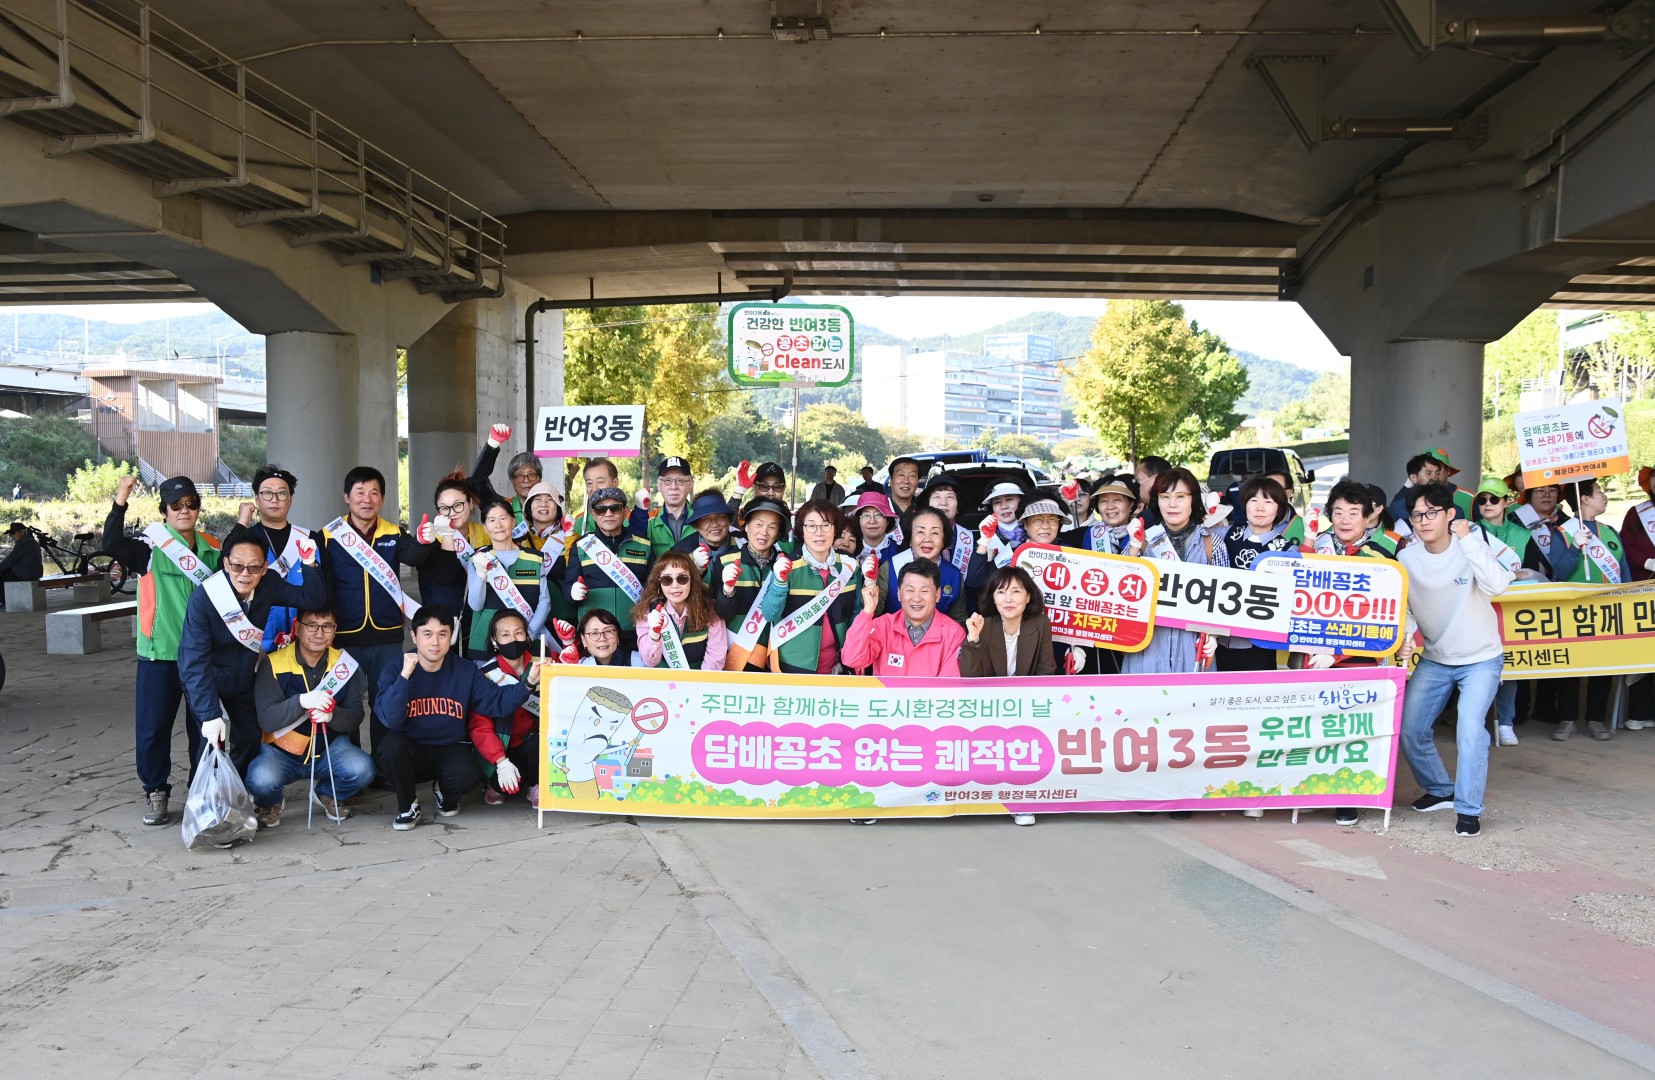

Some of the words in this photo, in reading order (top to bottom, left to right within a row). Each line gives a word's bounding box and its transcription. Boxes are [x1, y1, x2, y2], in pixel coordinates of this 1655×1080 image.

[746, 317, 784, 330] 건강한
[789, 317, 841, 333] 반여3동
[777, 335, 843, 352] 꽁초없는
[774, 354, 845, 370] Clean도시
[544, 415, 634, 442] 반여3동
[1522, 421, 1569, 437] 담배꽁초는
[1525, 438, 1534, 449] 꼭
[1537, 430, 1584, 447] 쓰레기통에
[1554, 465, 1580, 476] 해운대구
[1583, 461, 1608, 472] 반여4동
[357, 542, 388, 571] 담배꽁초
[1028, 550, 1056, 561] 반여3동
[612, 560, 640, 590] 담배꽁초
[1293, 569, 1372, 592] 담배꽁초
[1043, 592, 1056, 606] 집
[1059, 595, 1072, 608] 앞
[1075, 597, 1139, 619] 담배꽁초는
[1156, 573, 1280, 621] 반여3동
[793, 595, 830, 627] 담배꽁초
[1514, 606, 1563, 640] 우리
[1572, 602, 1624, 637] 함께
[745, 610, 764, 635] NO
[777, 619, 797, 639] NO
[1051, 625, 1075, 635] 반여3동
[1075, 628, 1113, 642] 행정복지센터
[1072, 612, 1118, 633] 치우자
[1325, 622, 1394, 640] 쓰레기통에
[661, 630, 683, 669] 담배꽁초
[1299, 636, 1324, 644] 반여3동
[701, 693, 767, 715] 주민과
[773, 696, 860, 718] 함께하는
[867, 698, 1023, 719] 도시환경정비의
[1031, 698, 1053, 718] 날
[1209, 696, 1226, 707] 살기
[1227, 696, 1242, 706] 좋은
[1245, 696, 1263, 705] 도시,
[1264, 695, 1280, 704] 오고
[1282, 694, 1297, 705] 싶은
[1300, 693, 1316, 703] 도시
[1318, 688, 1378, 710] 해운대
[1258, 716, 1312, 741] 우리
[1321, 712, 1375, 738] 함께
[704, 733, 843, 771] 담배꽁초
[854, 737, 924, 772] 없는
[934, 738, 1043, 772] 쾌적한
[1058, 725, 1251, 775] 반여3동
[1256, 740, 1369, 768] 만들어요
[944, 790, 994, 801] 반여3동
[997, 789, 1078, 800] 행정복지센터
